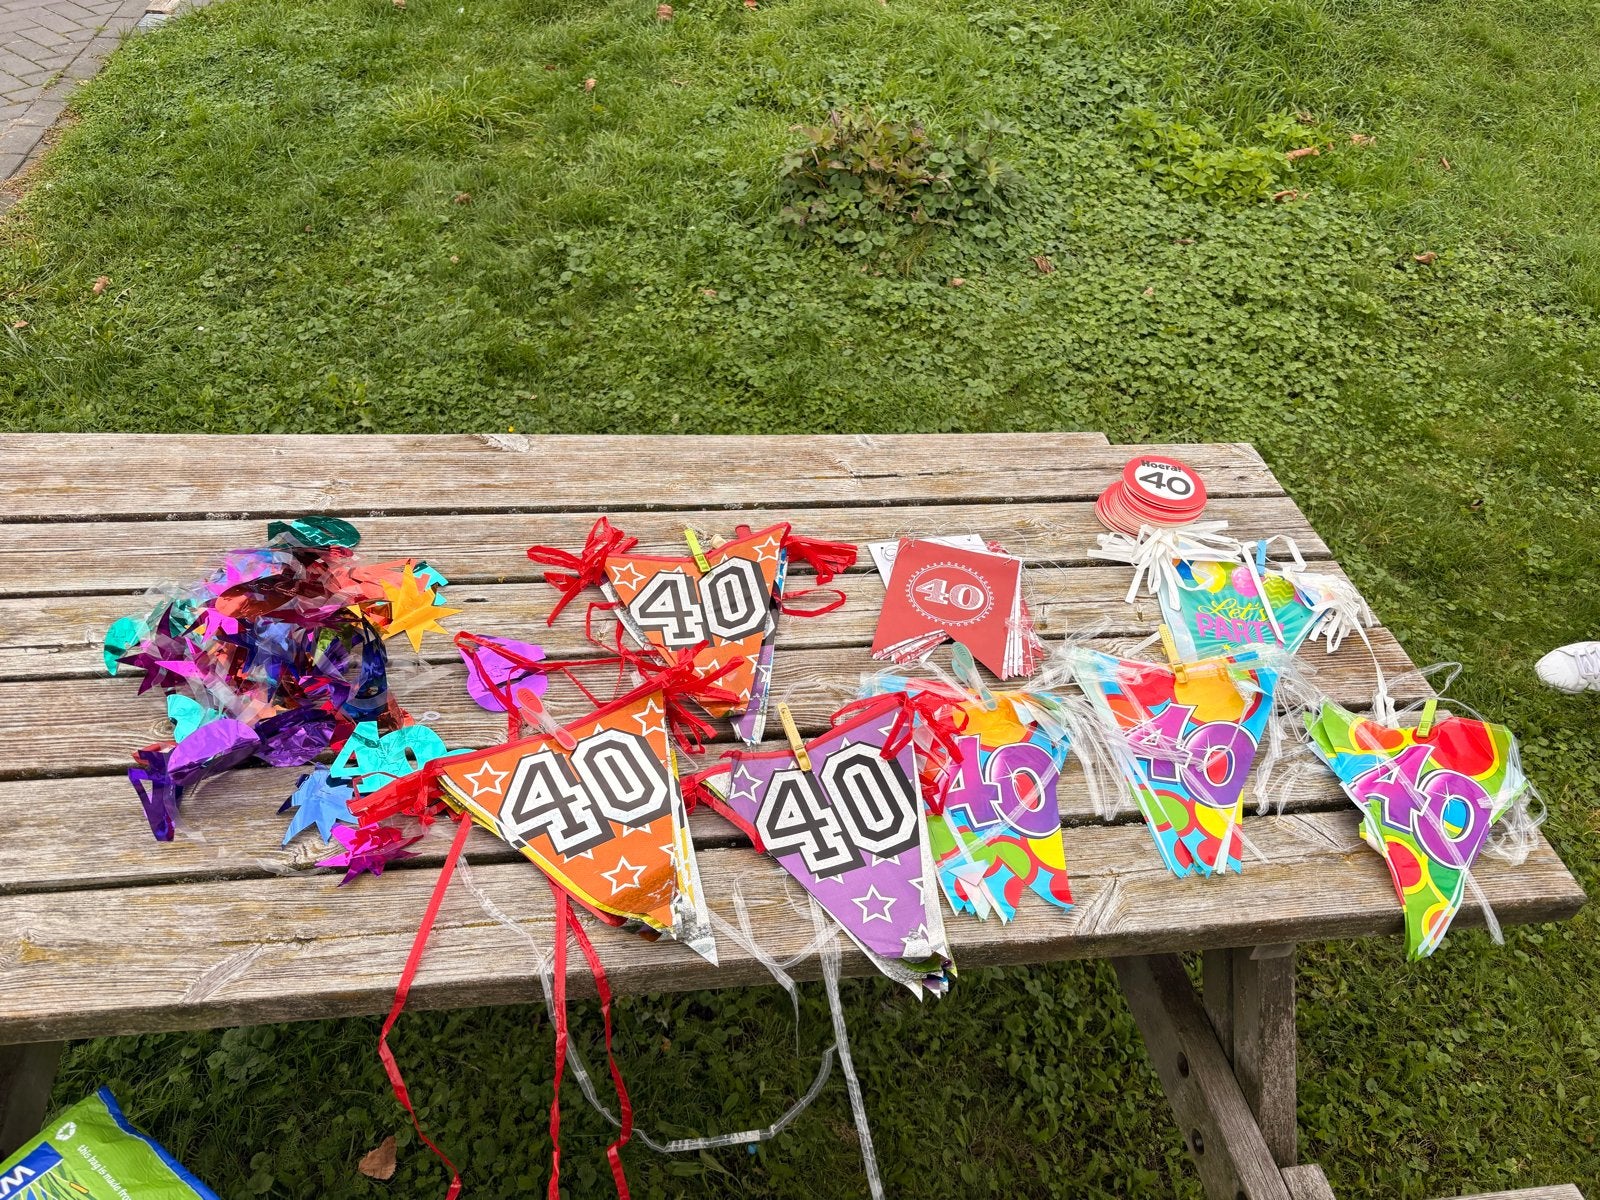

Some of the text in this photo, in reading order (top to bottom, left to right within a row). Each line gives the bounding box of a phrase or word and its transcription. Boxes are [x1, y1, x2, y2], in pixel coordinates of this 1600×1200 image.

[1139, 471, 1191, 496] 40
[1140, 459, 1182, 473] Hoera!
[628, 556, 771, 651] 40
[915, 578, 985, 611] 40
[1197, 598, 1268, 623] Let's
[498, 727, 672, 859] 40
[933, 733, 1061, 840] 40
[1121, 702, 1259, 809] 40
[753, 740, 921, 880] 40
[1350, 744, 1495, 871] 40
[77, 1144, 132, 1200] this bag is made fro
